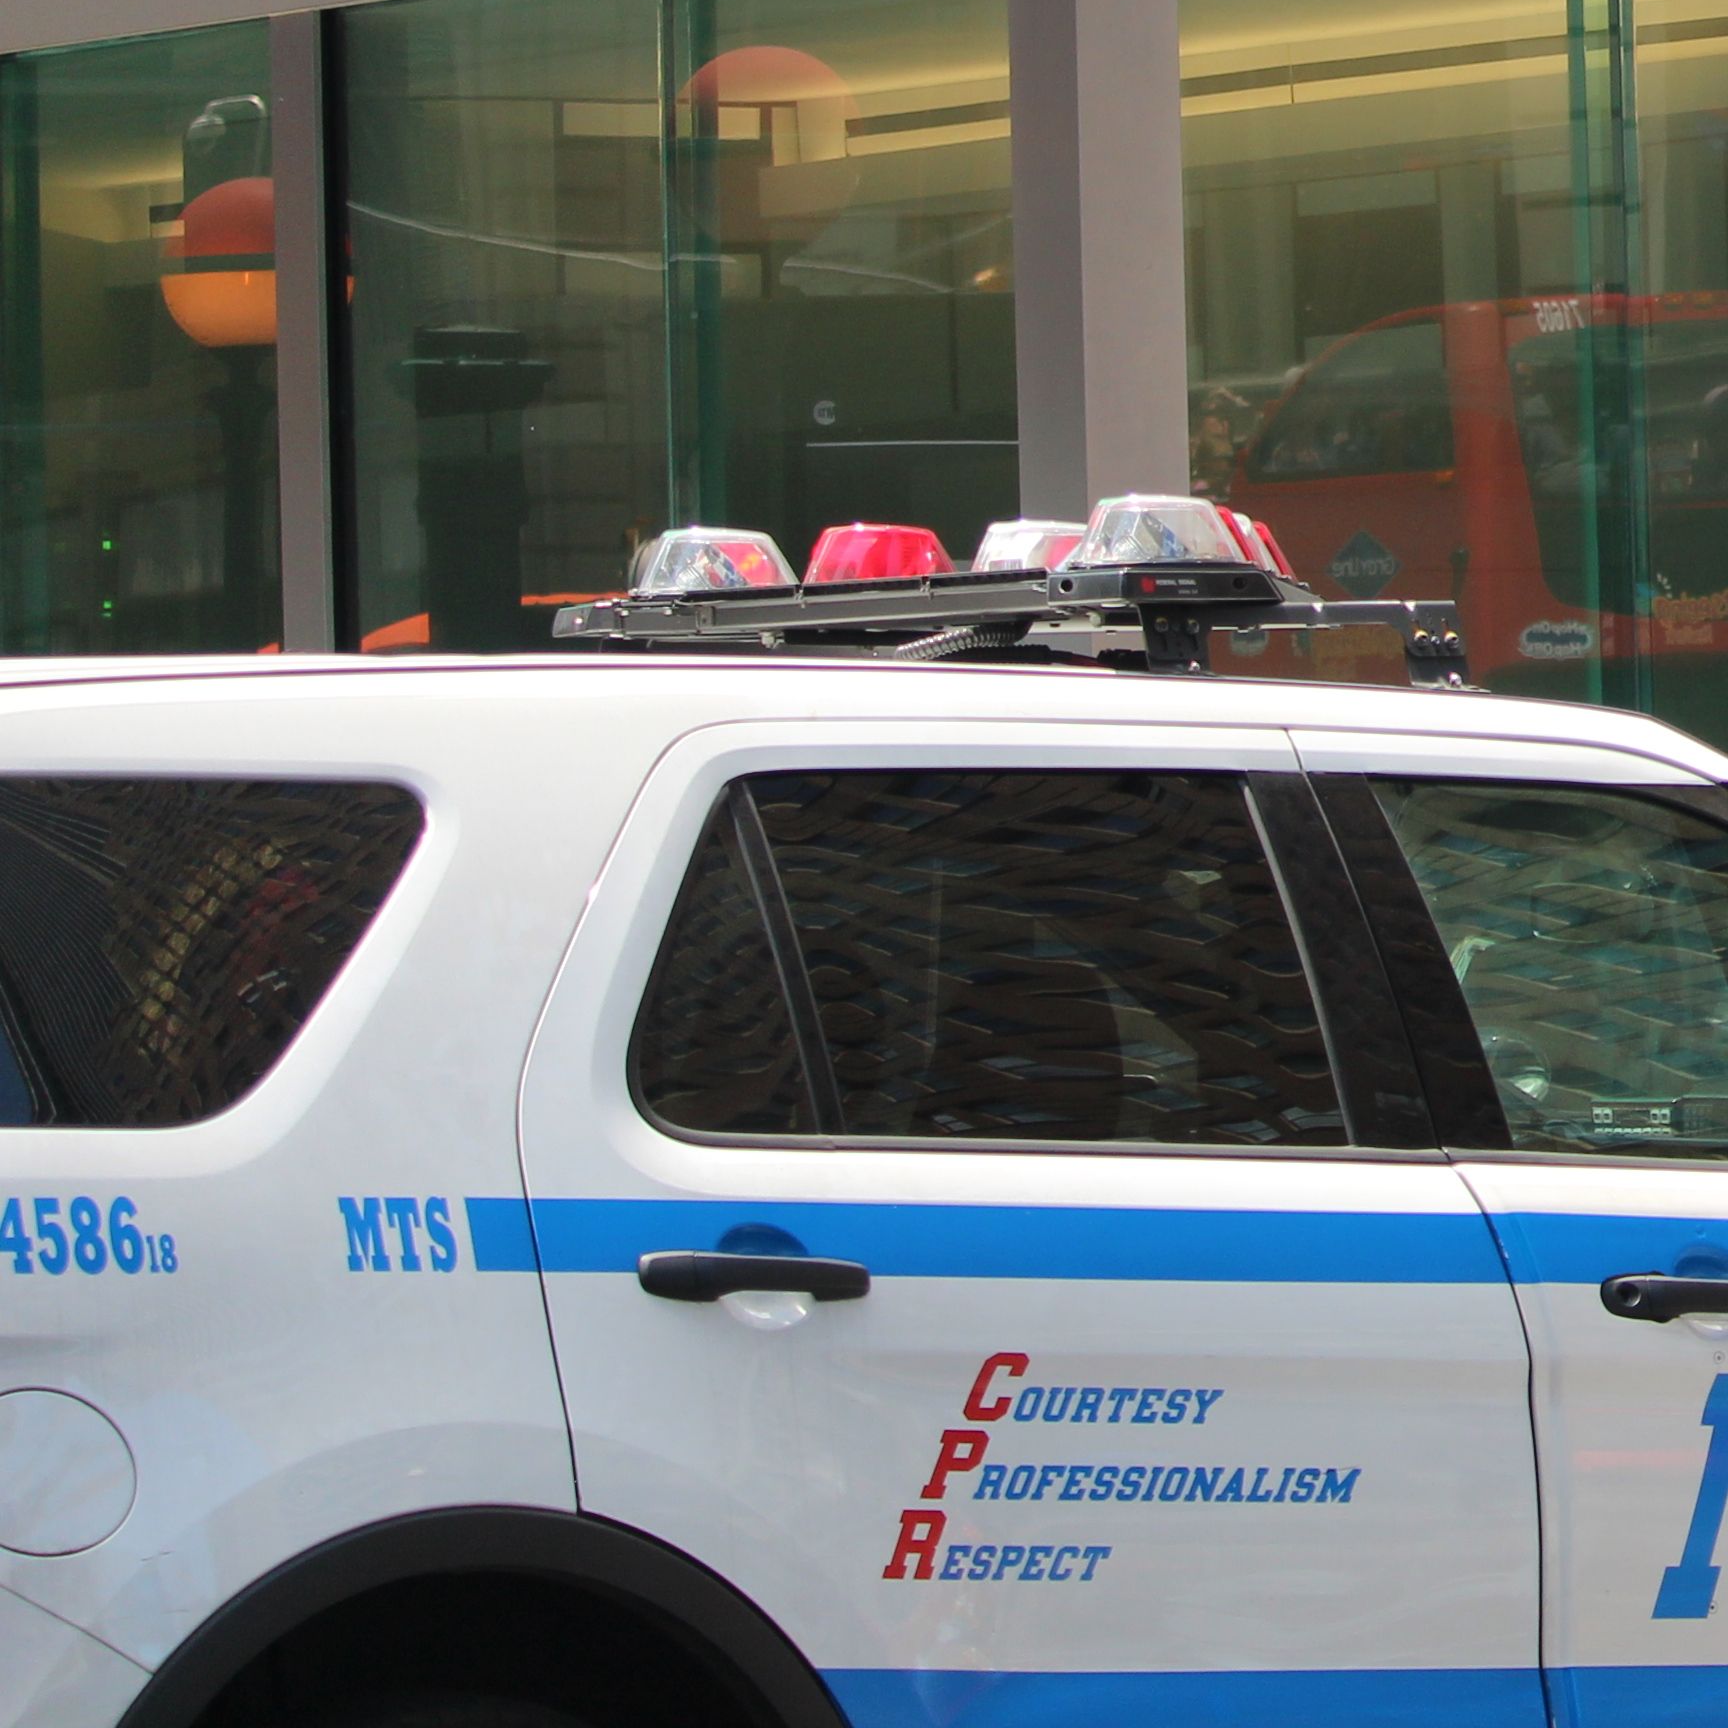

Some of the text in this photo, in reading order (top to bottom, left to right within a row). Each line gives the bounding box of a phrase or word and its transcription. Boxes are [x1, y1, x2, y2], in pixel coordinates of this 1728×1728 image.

[338, 1194, 459, 1274] MTS
[963, 1352, 1224, 1424] COURTESY
[920, 1429, 1362, 1504] PROFESSIONALISM
[882, 1509, 1112, 1581] RESPECT
